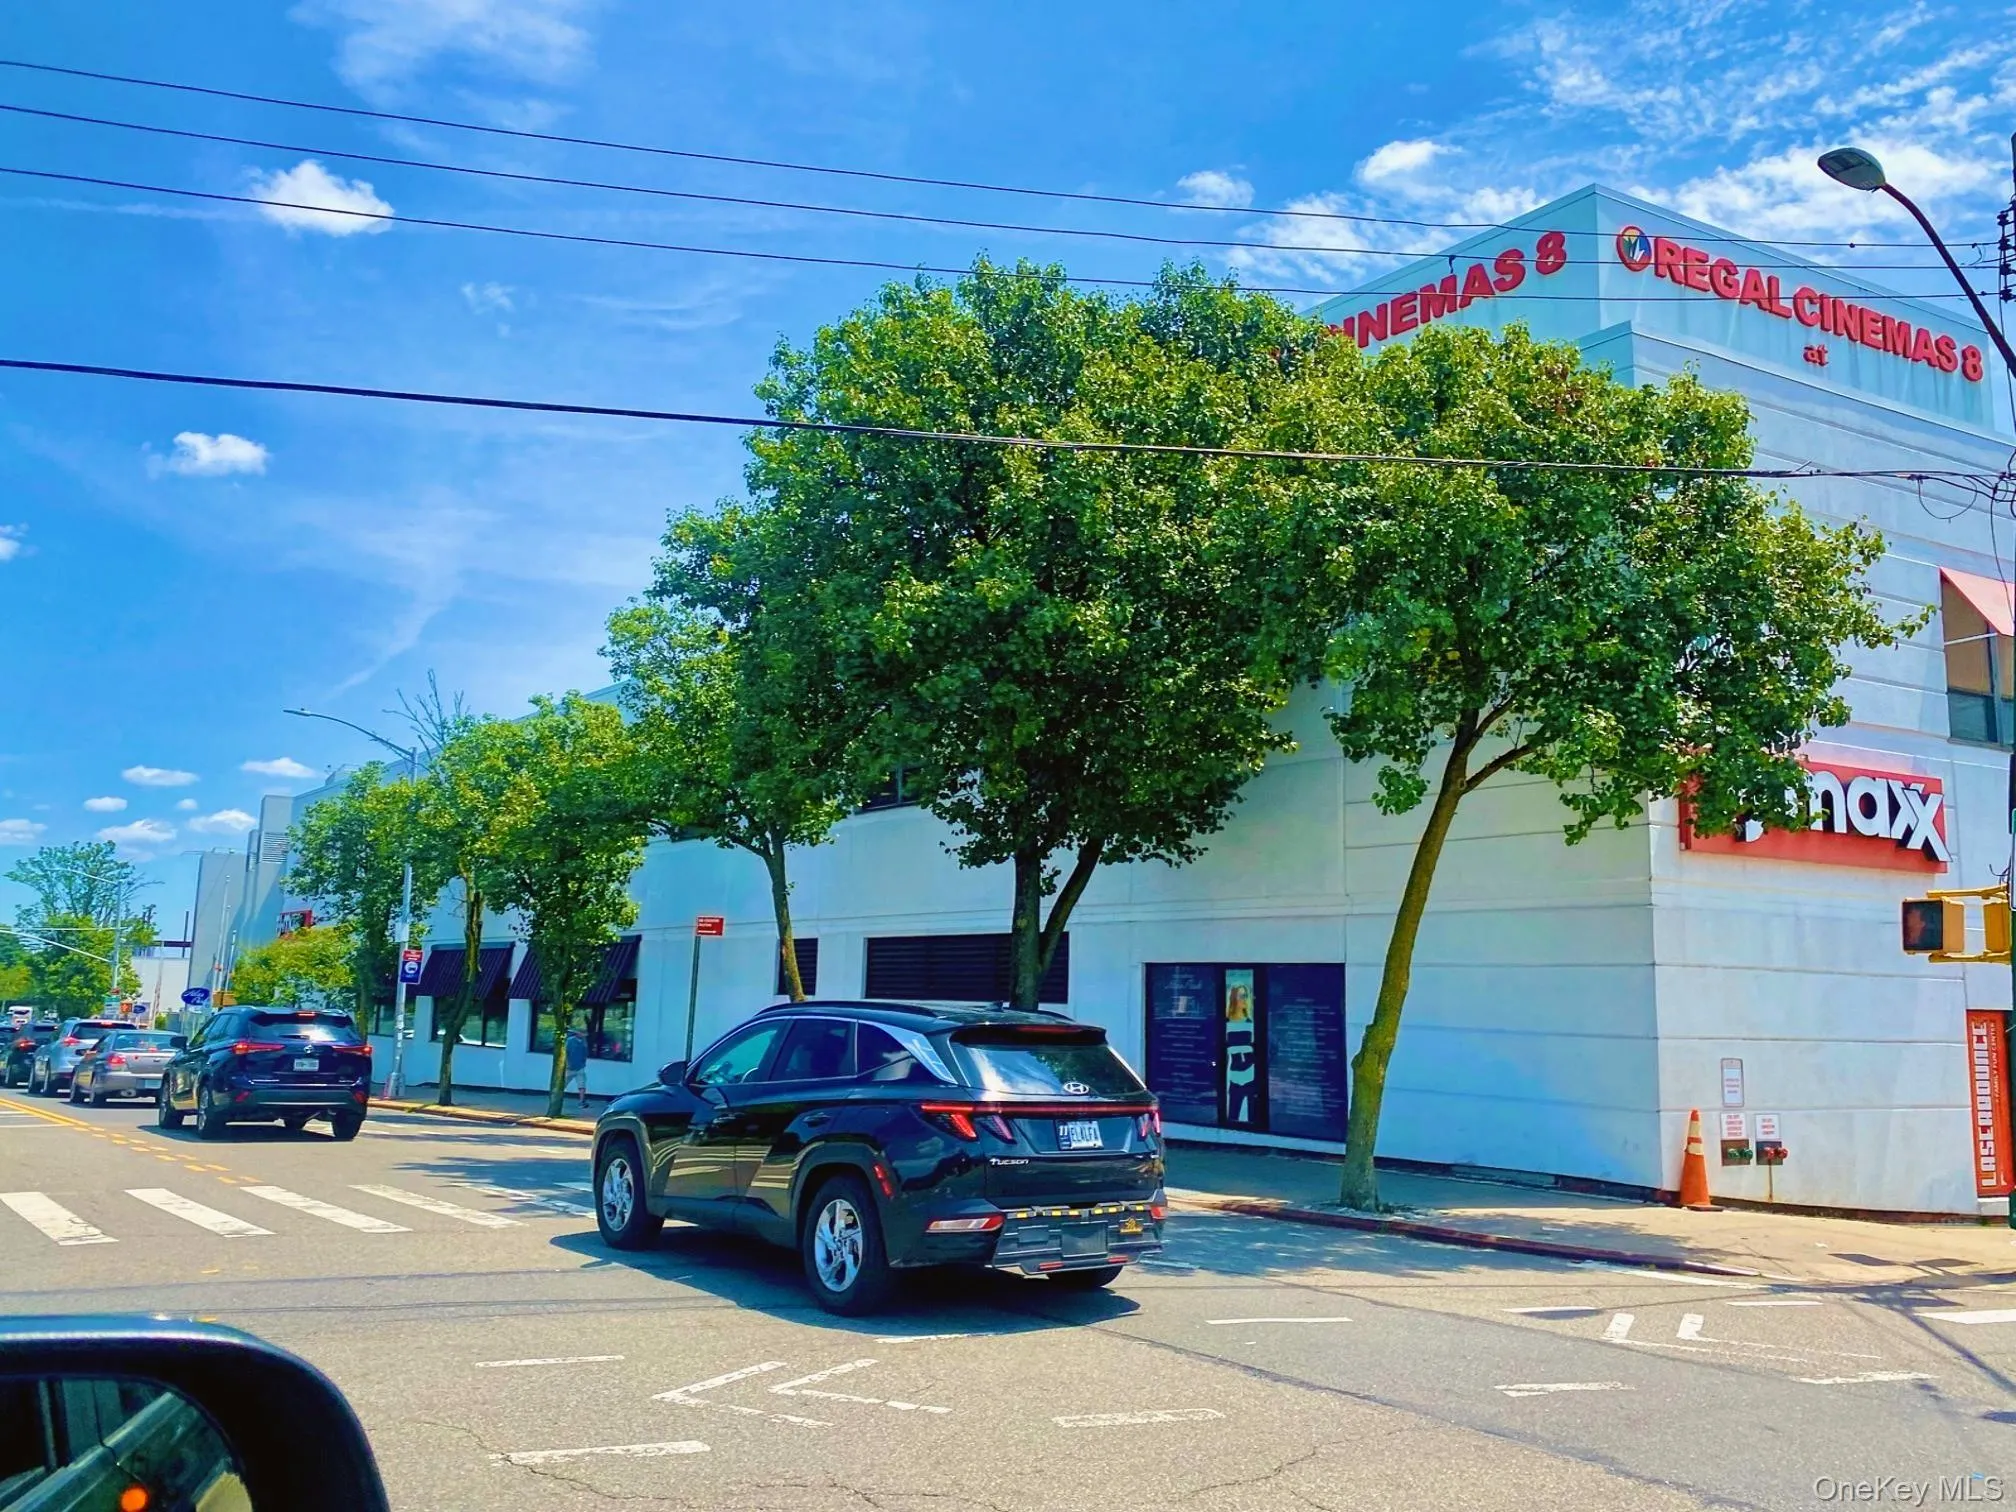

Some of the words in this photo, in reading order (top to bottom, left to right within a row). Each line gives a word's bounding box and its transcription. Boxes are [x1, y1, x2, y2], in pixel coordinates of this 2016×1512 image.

[1329, 249, 1526, 348] INEMAS
[1535, 231, 1567, 275] 8
[1653, 236, 1792, 319] REGAL
[1792, 286, 1958, 373] CINEMAS
[1961, 344, 1984, 382] 8
[1803, 343, 1829, 366] at
